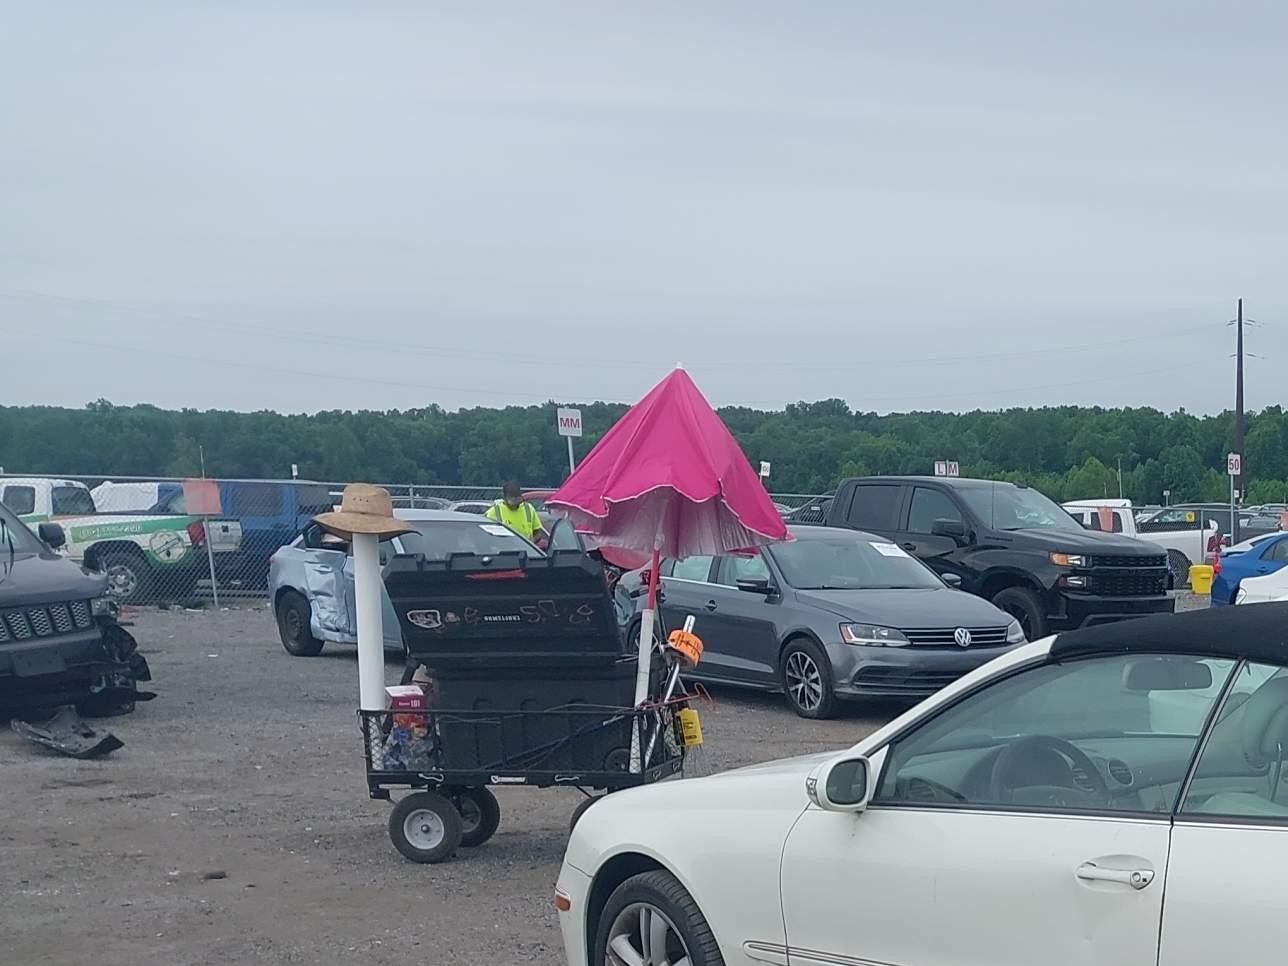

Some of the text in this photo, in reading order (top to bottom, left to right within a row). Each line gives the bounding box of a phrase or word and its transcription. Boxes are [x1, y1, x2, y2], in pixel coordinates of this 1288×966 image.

[560, 417, 580, 429] MM
[937, 463, 943, 474] L
[948, 463, 958, 474] M
[1228, 459, 1240, 471] 50
